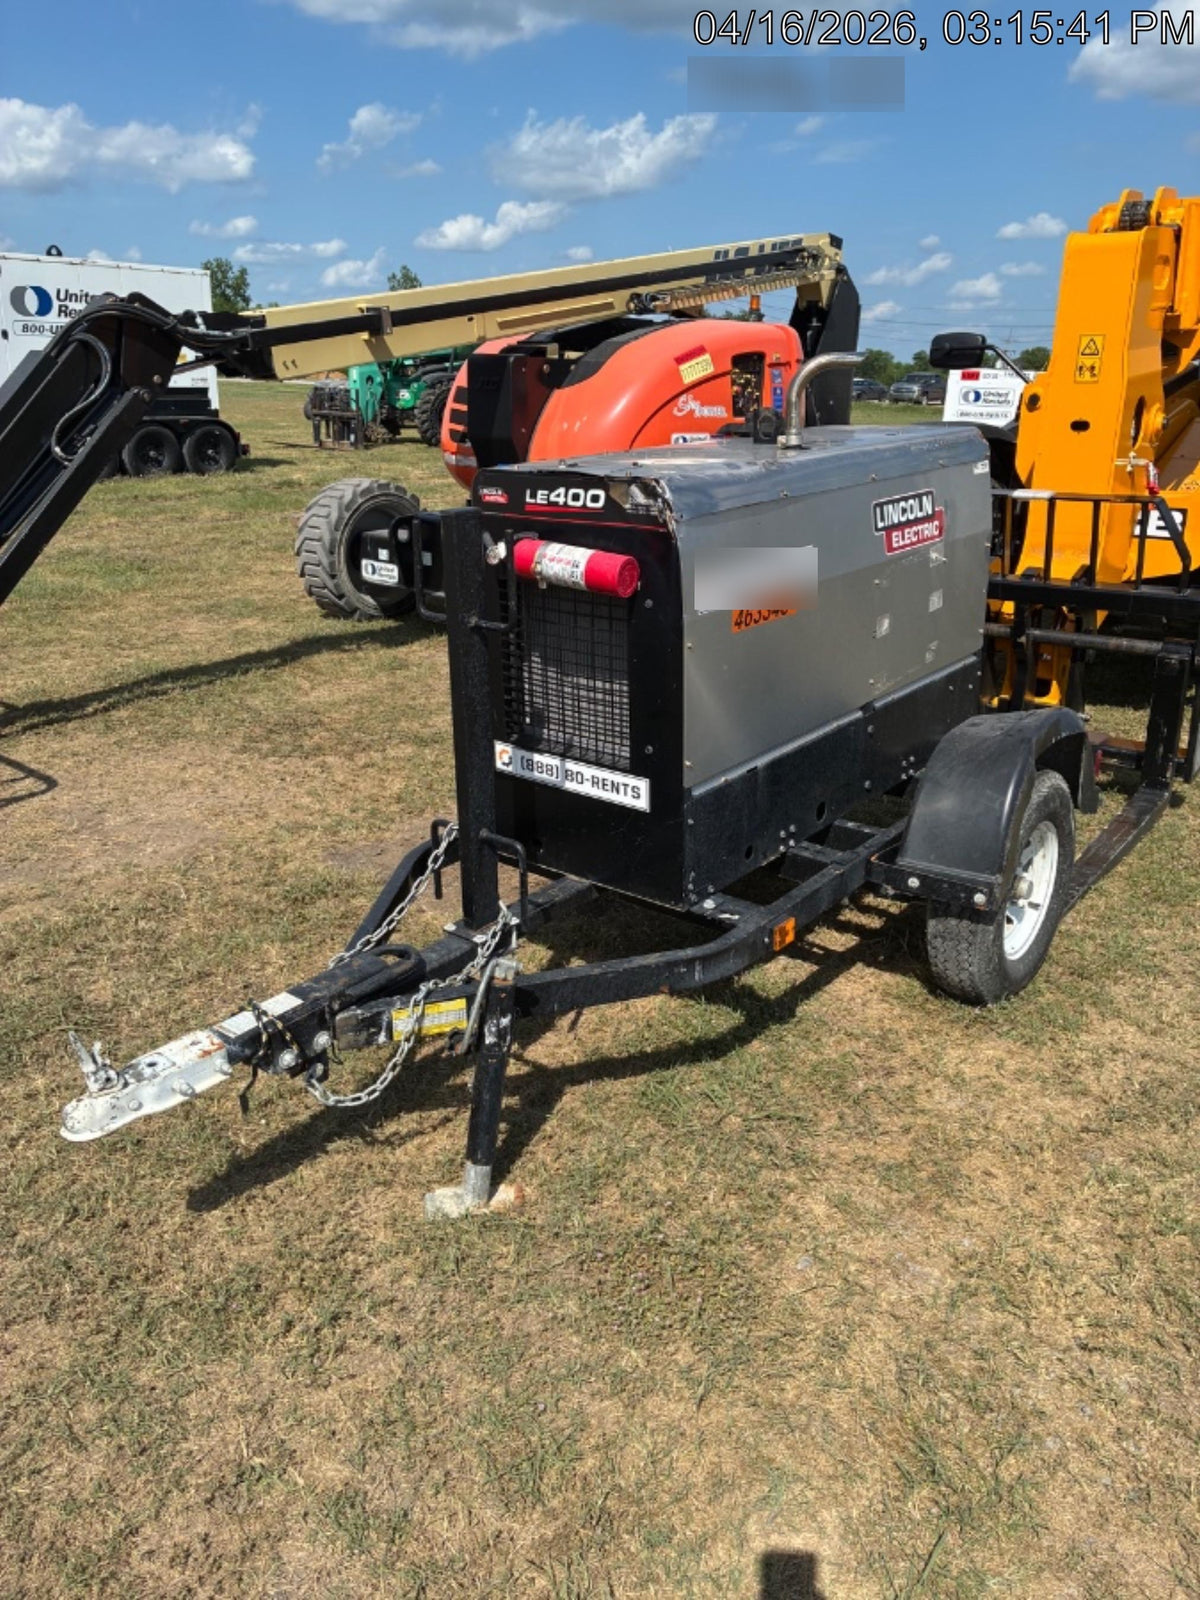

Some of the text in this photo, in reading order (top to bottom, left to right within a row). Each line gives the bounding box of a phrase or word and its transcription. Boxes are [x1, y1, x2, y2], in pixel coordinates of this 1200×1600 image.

[56, 288, 92, 304] Unit
[525, 486, 606, 508] LE400
[875, 494, 933, 529] LINCOLN
[891, 520, 940, 548] ELECTRIC
[520, 755, 559, 779] (888)
